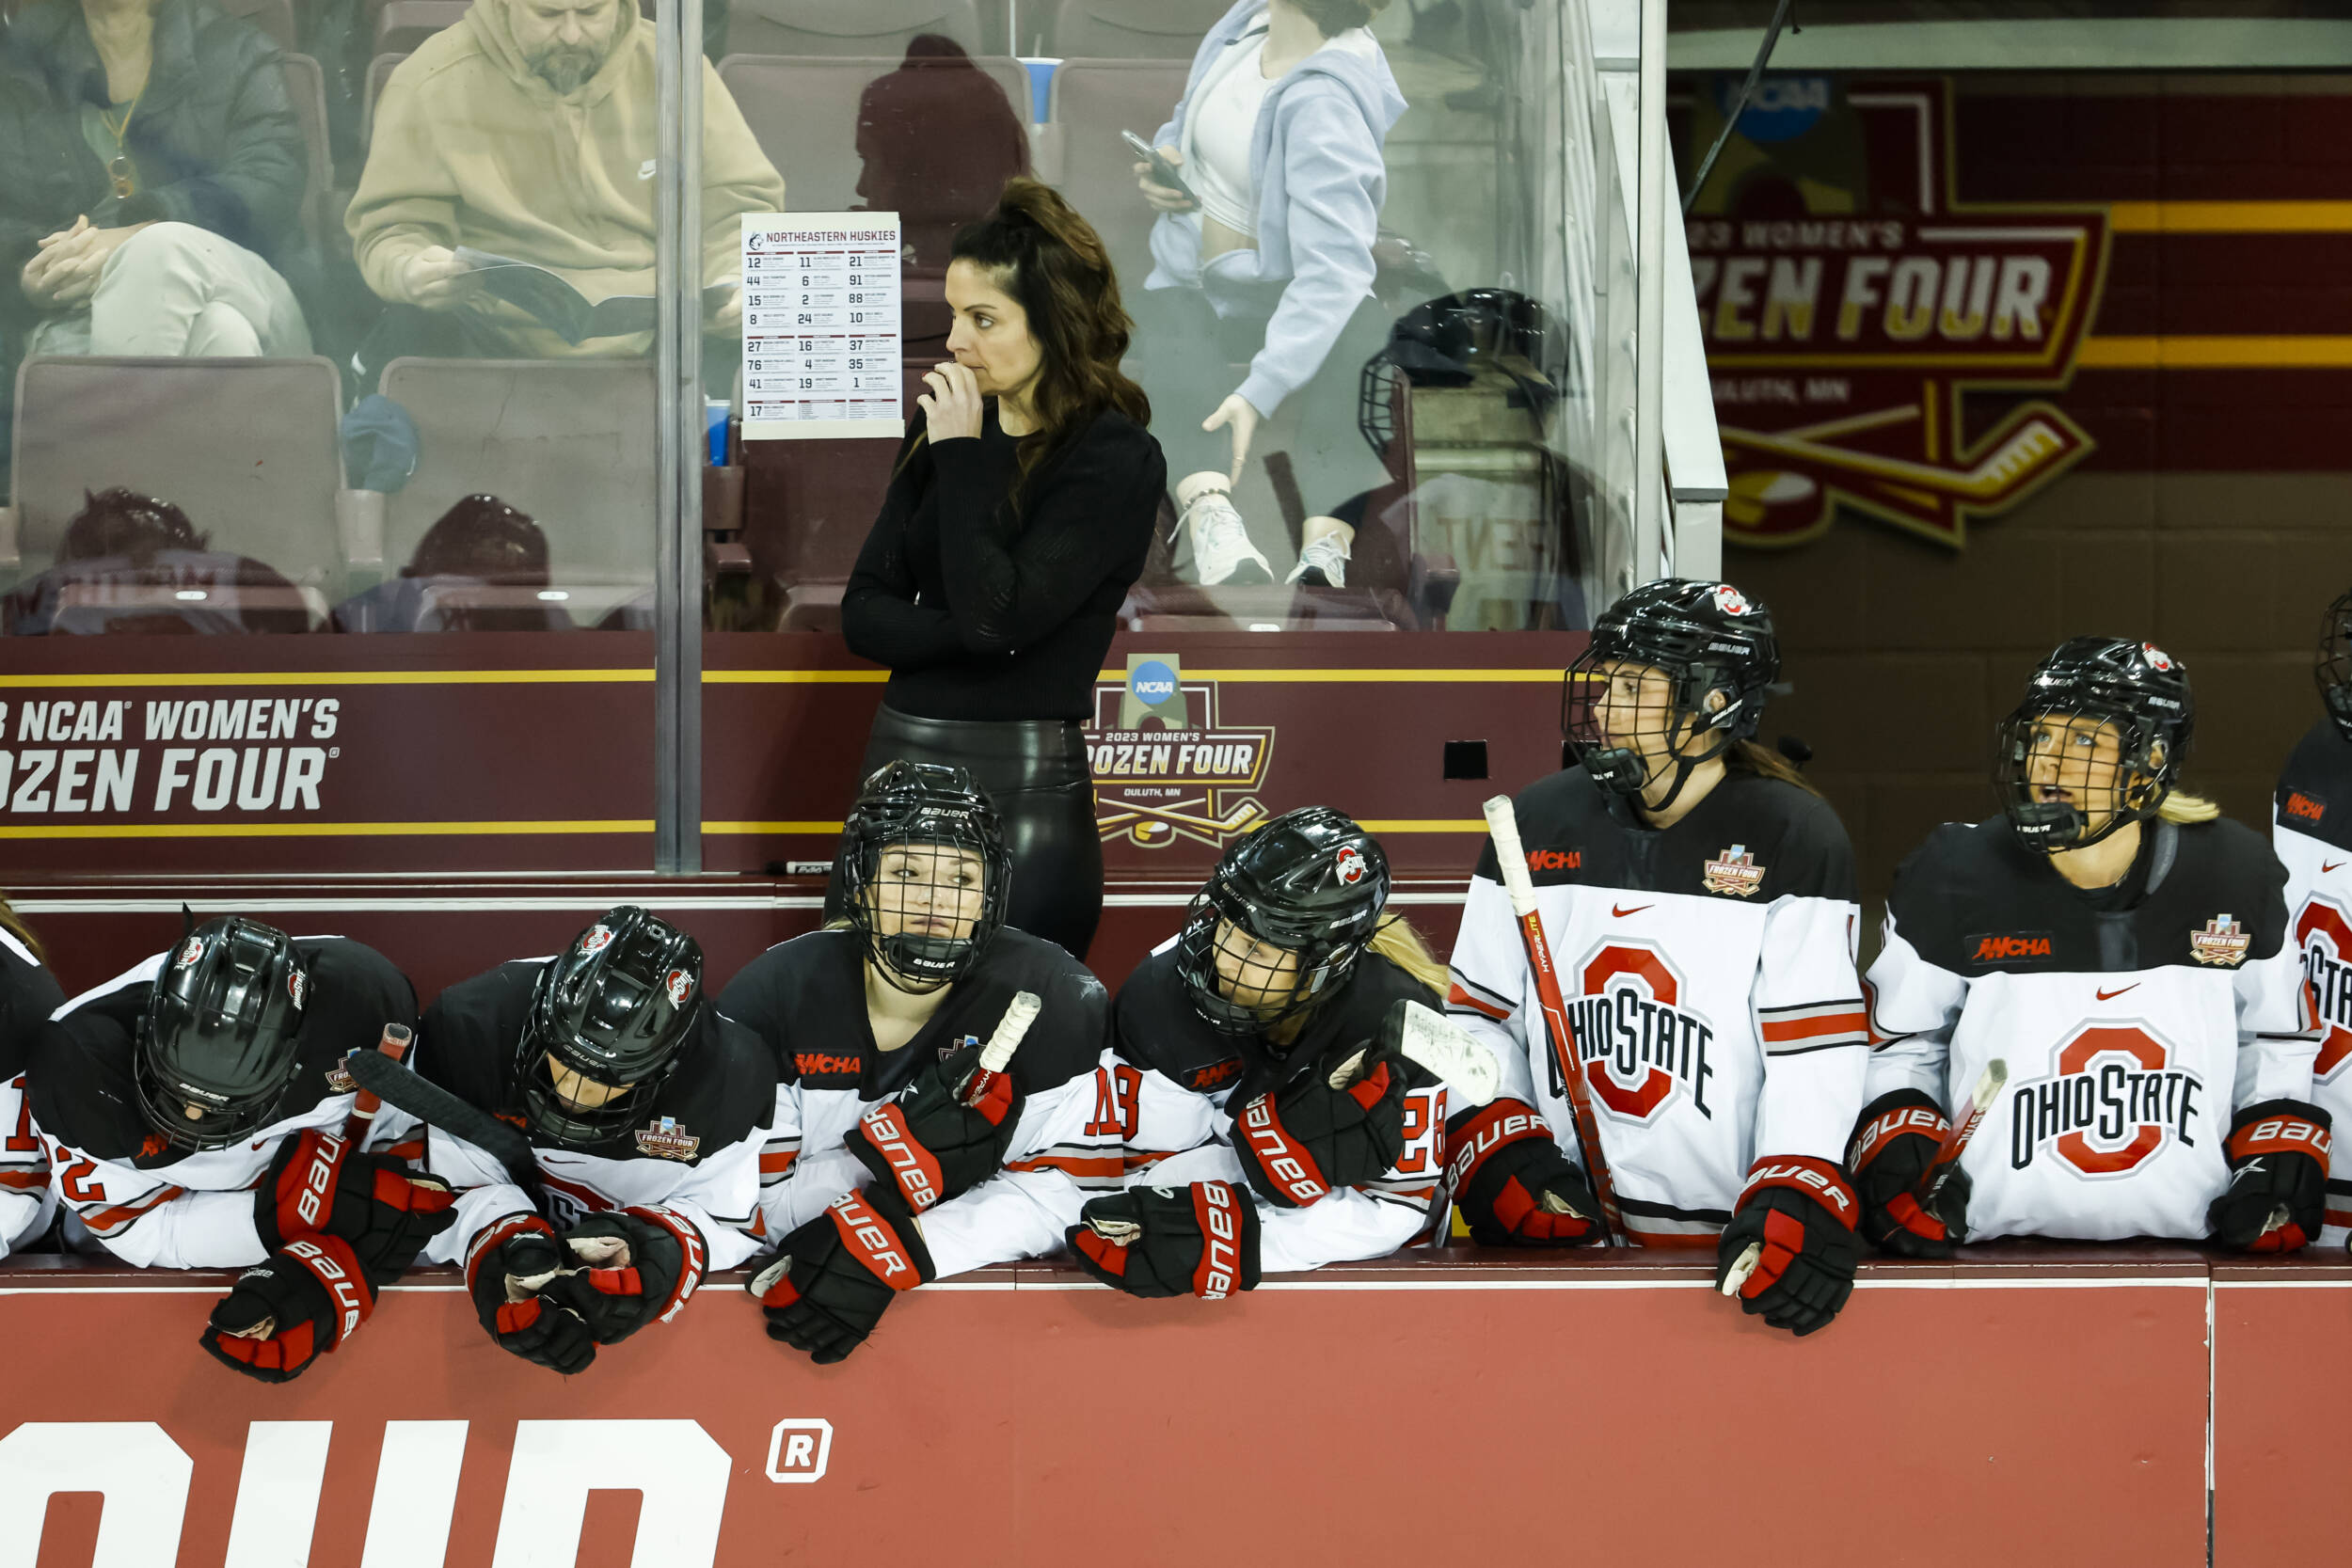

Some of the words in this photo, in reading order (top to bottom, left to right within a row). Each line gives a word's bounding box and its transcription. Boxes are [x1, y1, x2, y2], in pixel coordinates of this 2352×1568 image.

[766, 231, 847, 243] NORTHEASTERN
[850, 230, 896, 242] HUSKIES
[747, 257, 761, 268] 12
[800, 257, 811, 268] 11
[850, 256, 862, 267] 21
[746, 276, 760, 286] 44
[802, 276, 809, 286] 6
[850, 275, 863, 285] 91
[748, 295, 761, 306] 15
[802, 294, 809, 305] 2
[849, 293, 863, 304] 88
[1836, 256, 2051, 341] FOUR
[750, 314, 757, 325] 8
[798, 313, 812, 324] 24
[850, 312, 863, 323] 10
[748, 341, 761, 352] 27
[799, 341, 812, 352] 16
[850, 340, 863, 351] 37
[747, 359, 762, 371] 76
[805, 359, 812, 370] 4
[849, 358, 864, 369] 35
[749, 378, 762, 388] 41
[799, 378, 812, 388] 19
[853, 377, 860, 388] 1
[750, 406, 762, 417] 17
[1136, 681, 1174, 693] NCAA
[145, 698, 340, 741] WOMEN'S
[1105, 732, 1139, 742] 2023
[1142, 732, 1200, 742] WOMEN'S
[1087, 744, 1171, 775] OZEN
[1176, 744, 1253, 775] FOUR
[0, 749, 140, 813] ZEN
[1123, 788, 1164, 798] DULUTH,
[1165, 787, 1181, 797] MN
[920, 807, 970, 819] BAUER
[1529, 915, 1550, 973] HYPERLITE
[1972, 936, 2052, 960] WCHA
[913, 958, 956, 969] BAUER
[794, 1053, 861, 1075] WCHA
[179, 1082, 230, 1102] BAUER
[642, 1133, 673, 1145] FROZEN
[673, 1138, 694, 1148] FOUR
[2248, 1120, 2331, 1155] BAU
[1246, 1092, 1326, 1200] BAUER
[864, 1105, 939, 1209] BAUER
[1446, 1114, 1553, 1198] BAUER
[296, 1132, 347, 1227] BAU
[1736, 1164, 1851, 1212] AUER
[830, 1193, 908, 1277] AUER
[1201, 1181, 1235, 1301] BAUER
